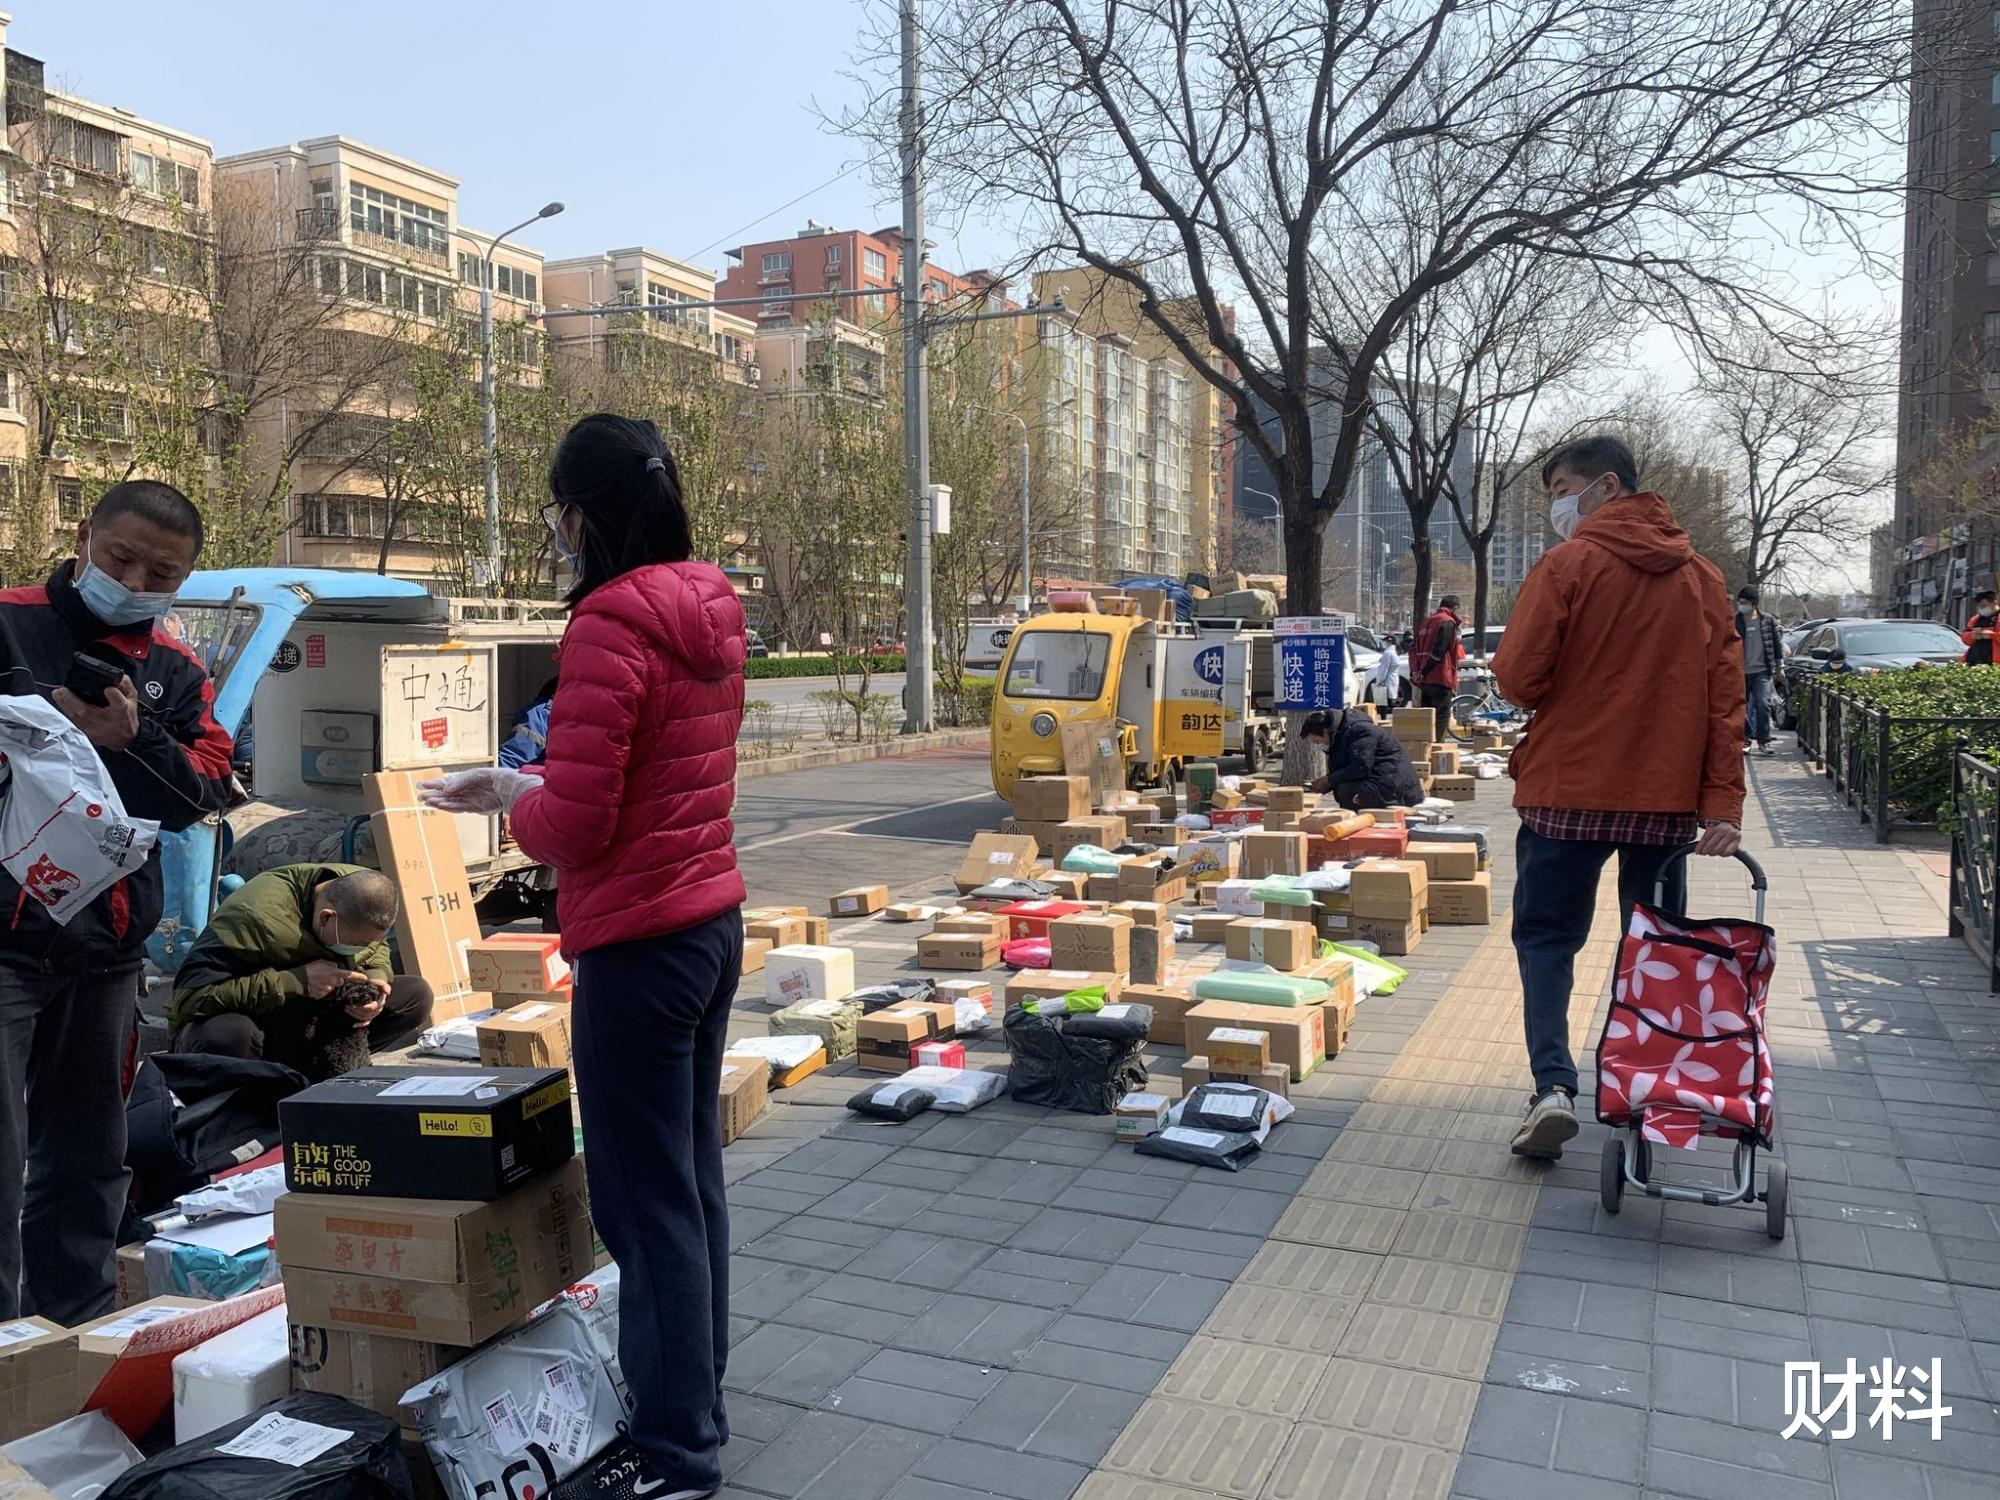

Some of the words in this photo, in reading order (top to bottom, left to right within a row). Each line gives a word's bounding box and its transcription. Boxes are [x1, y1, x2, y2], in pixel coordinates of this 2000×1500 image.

[1203, 652, 1222, 679] 快
[1283, 651, 1304, 702] 快递
[1314, 647, 1330, 708] 临时取件处
[402, 664, 486, 740] 中通
[1181, 713, 1222, 731] 韵达
[425, 1119, 458, 1132] Hello!
[332, 1144, 358, 1158] THE
[333, 1158, 372, 1173] GOOD
[334, 1173, 373, 1187] STUFF
